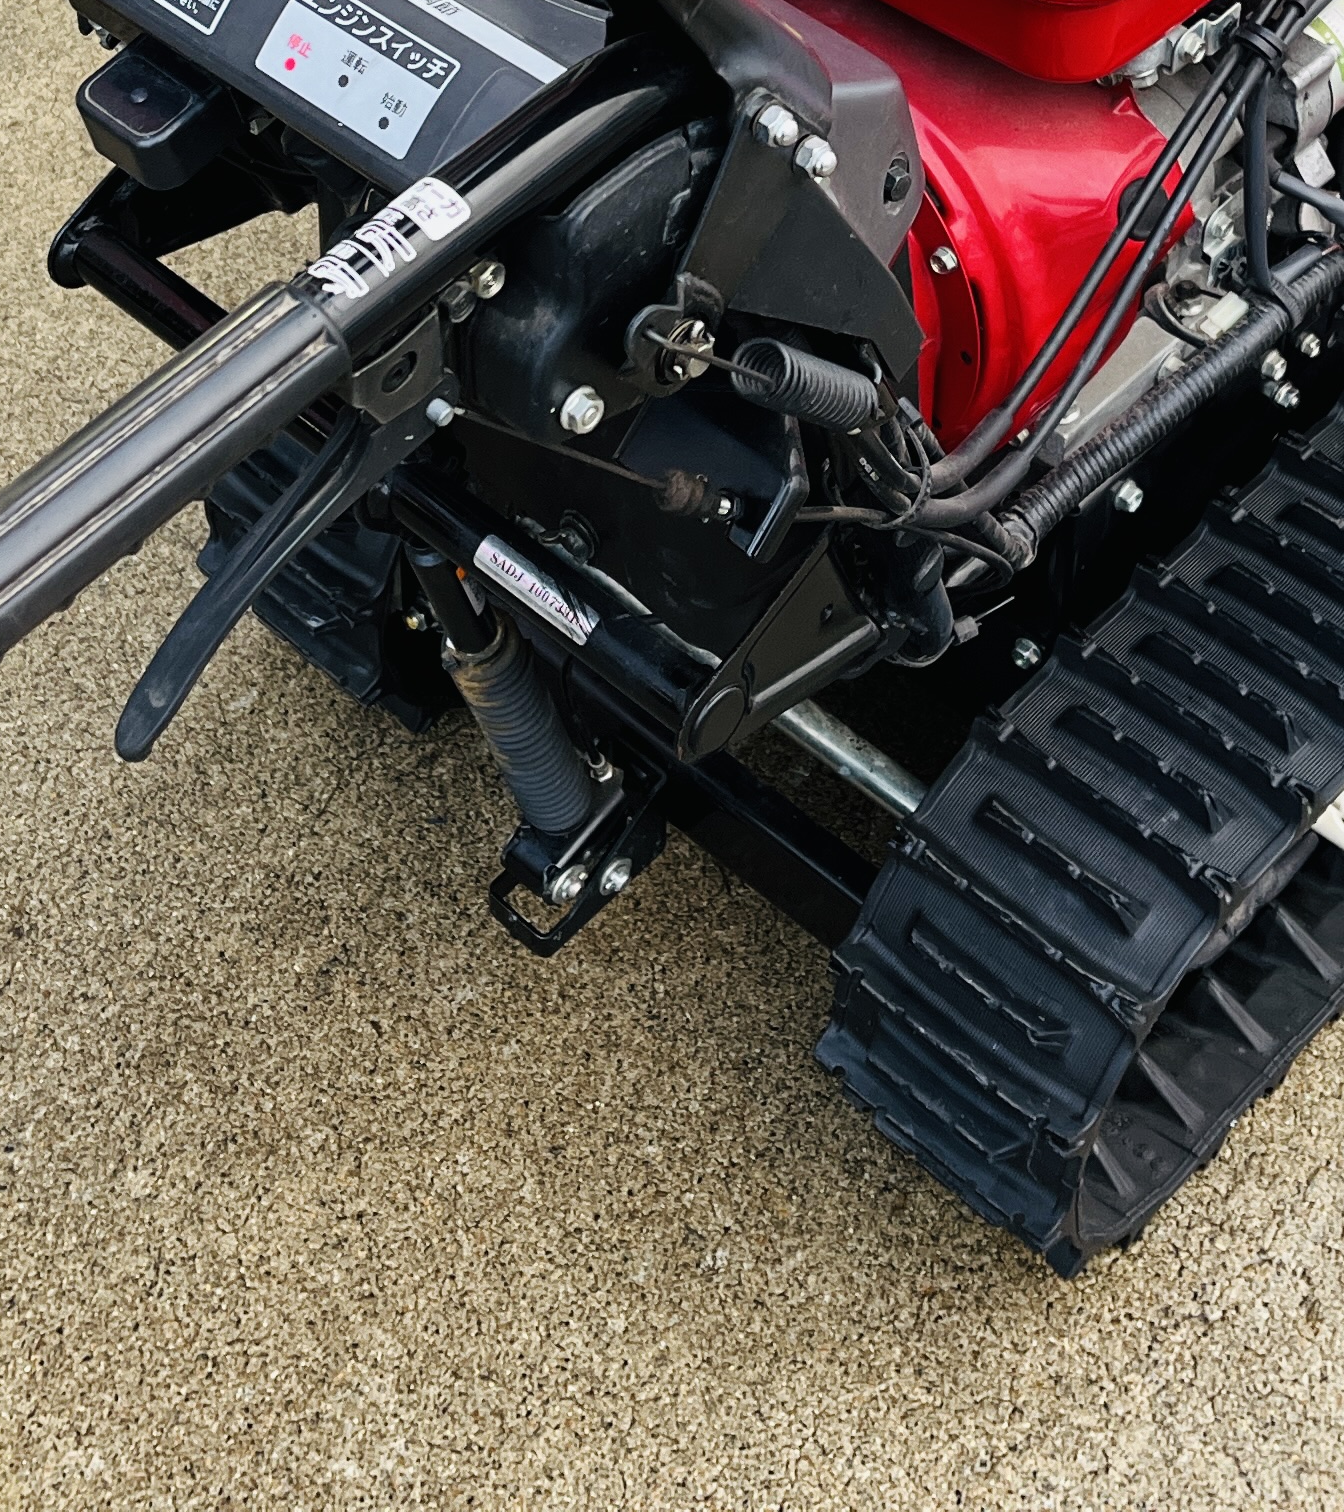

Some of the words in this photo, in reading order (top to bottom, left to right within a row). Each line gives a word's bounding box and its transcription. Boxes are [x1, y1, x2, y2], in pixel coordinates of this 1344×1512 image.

[286, 32, 314, 60] 停止
[340, 49, 370, 76] 運転
[379, 90, 409, 118] 始動
